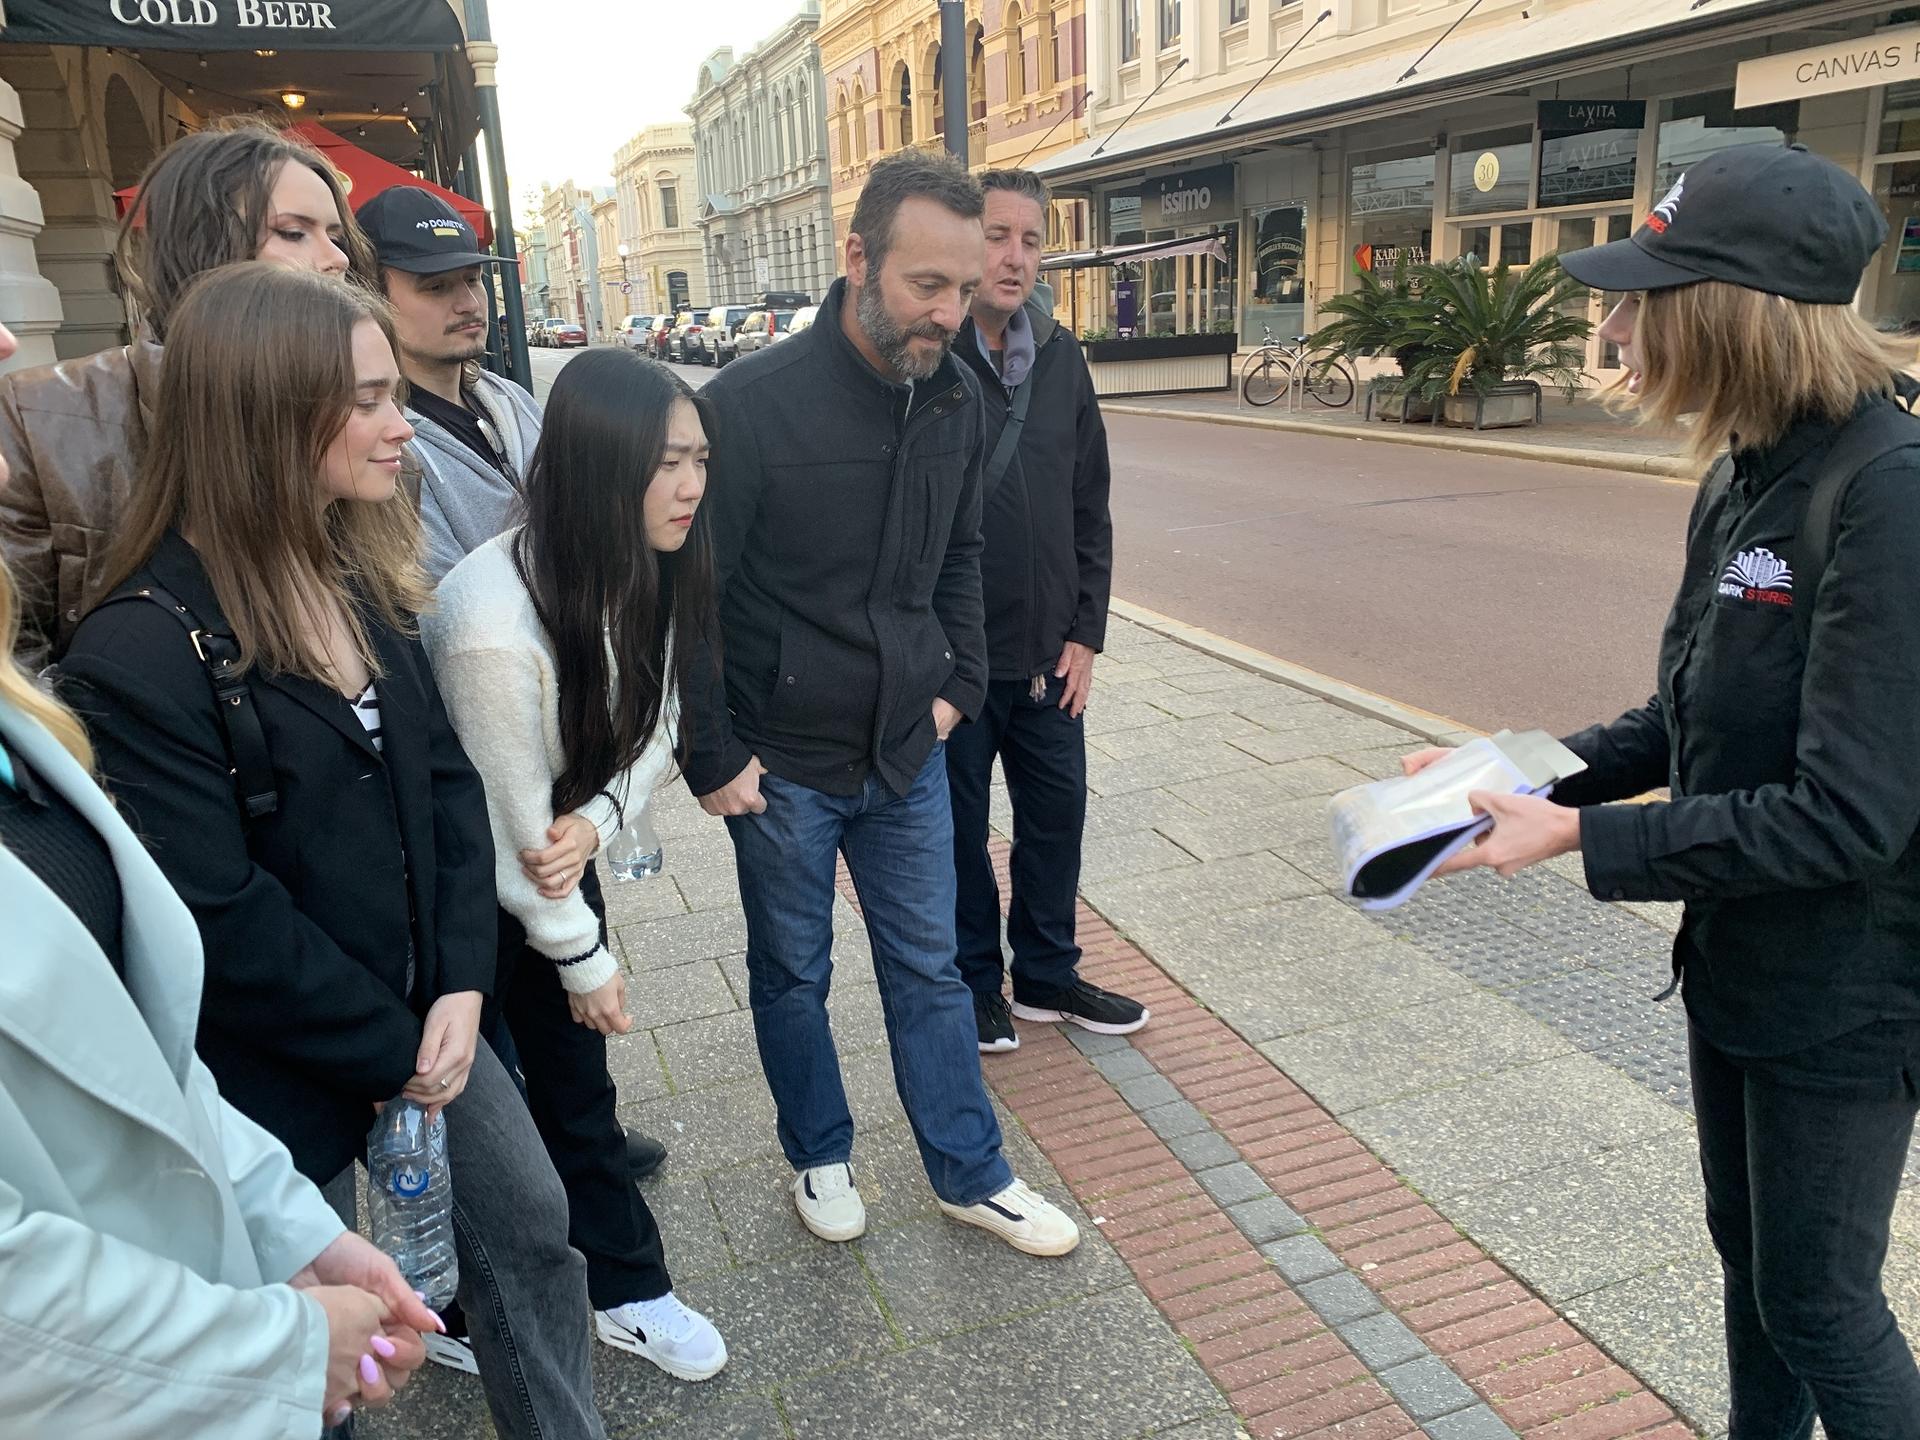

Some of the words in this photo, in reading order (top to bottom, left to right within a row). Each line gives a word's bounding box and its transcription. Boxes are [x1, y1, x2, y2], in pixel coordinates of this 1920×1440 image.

[237, 0, 336, 30] BEER
[1796, 46, 1901, 83] CANVAS
[1478, 162, 1495, 182] 30
[1161, 179, 1211, 215] issimo
[1375, 246, 1425, 261] KARDYA
[1375, 257, 1425, 268] KITCENS
[1717, 582, 1745, 598] DARK
[398, 1173, 422, 1185] nu
